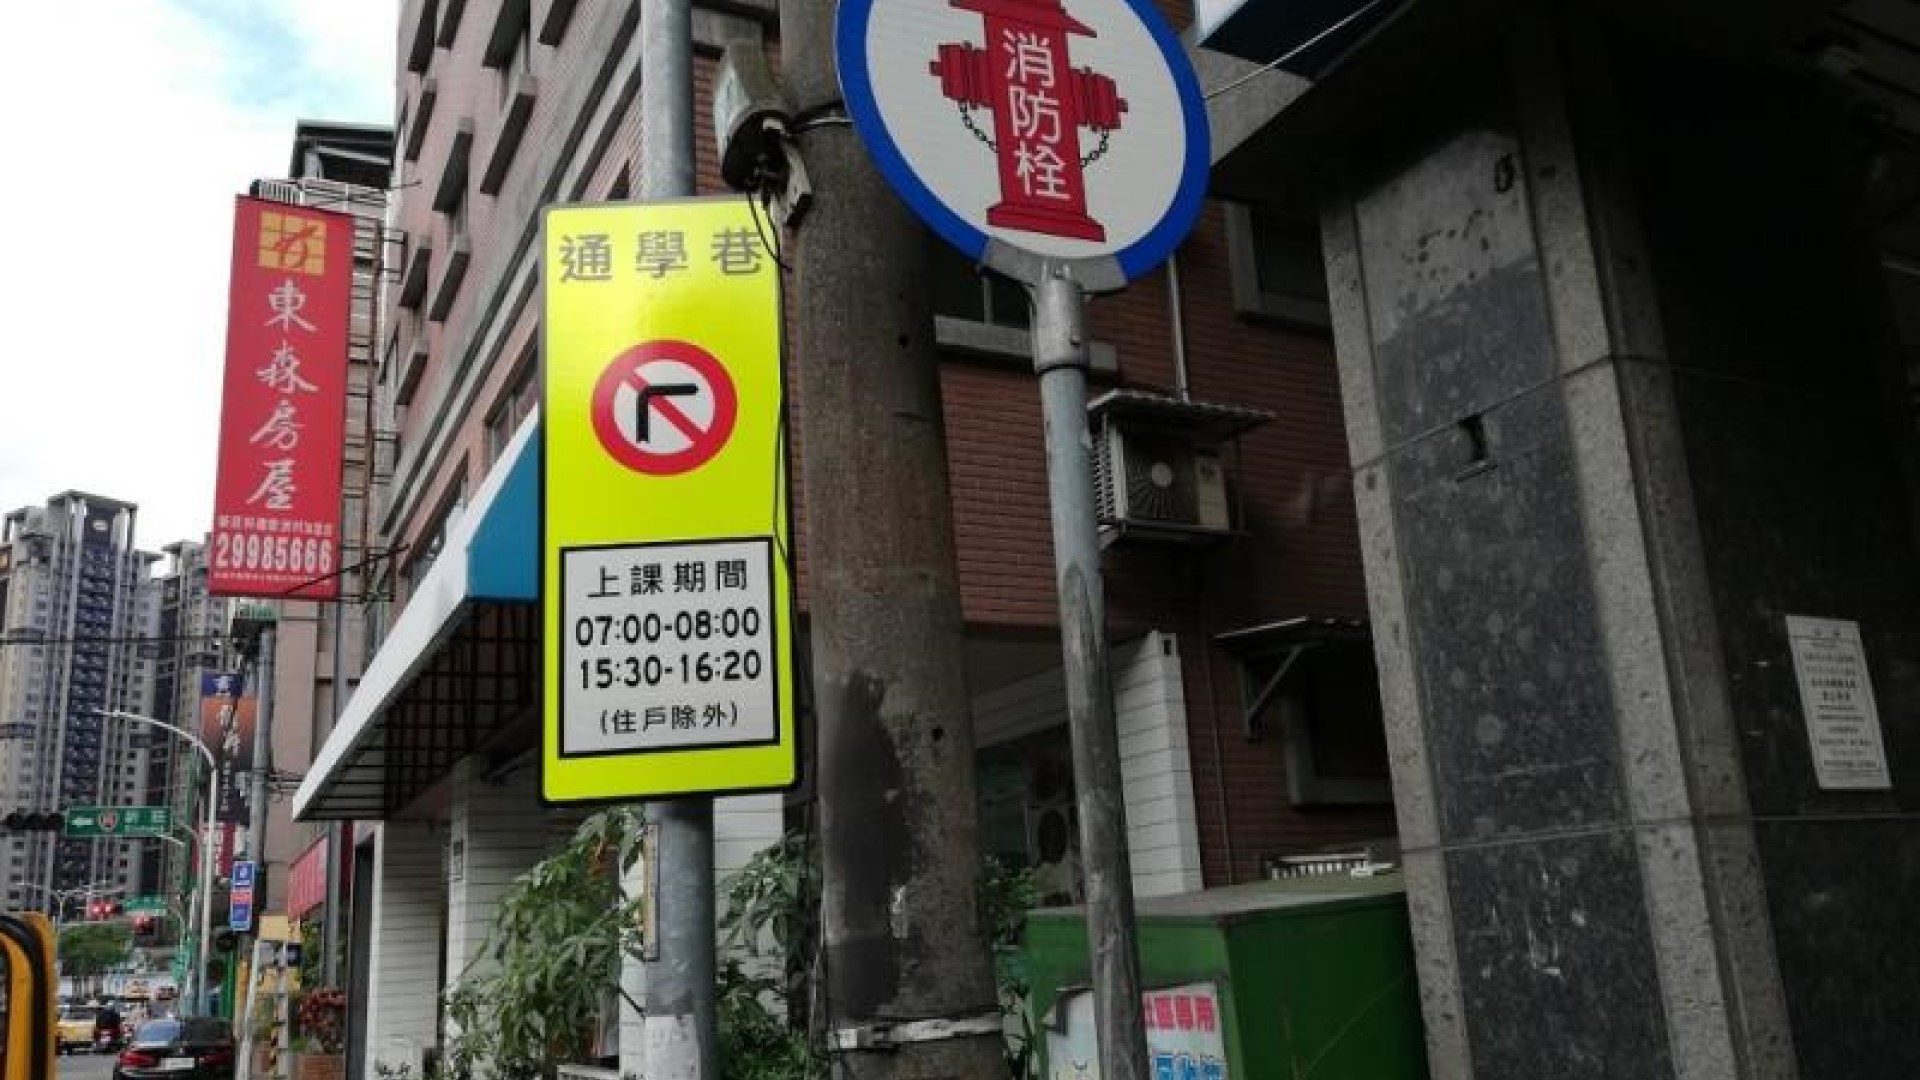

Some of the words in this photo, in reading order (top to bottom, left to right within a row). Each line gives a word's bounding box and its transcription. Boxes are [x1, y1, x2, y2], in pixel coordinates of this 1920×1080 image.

[1003, 28, 1071, 200] 消防栓
[559, 227, 763, 283] 通學巷
[246, 279, 319, 510] 東森房屋
[215, 532, 332, 574] 29985666
[587, 559, 747, 597] 上課期間
[576, 607, 760, 646] 07:00-08:00
[580, 649, 762, 690] 15:30-16:20
[600, 702, 738, 735] (住戶除外)
